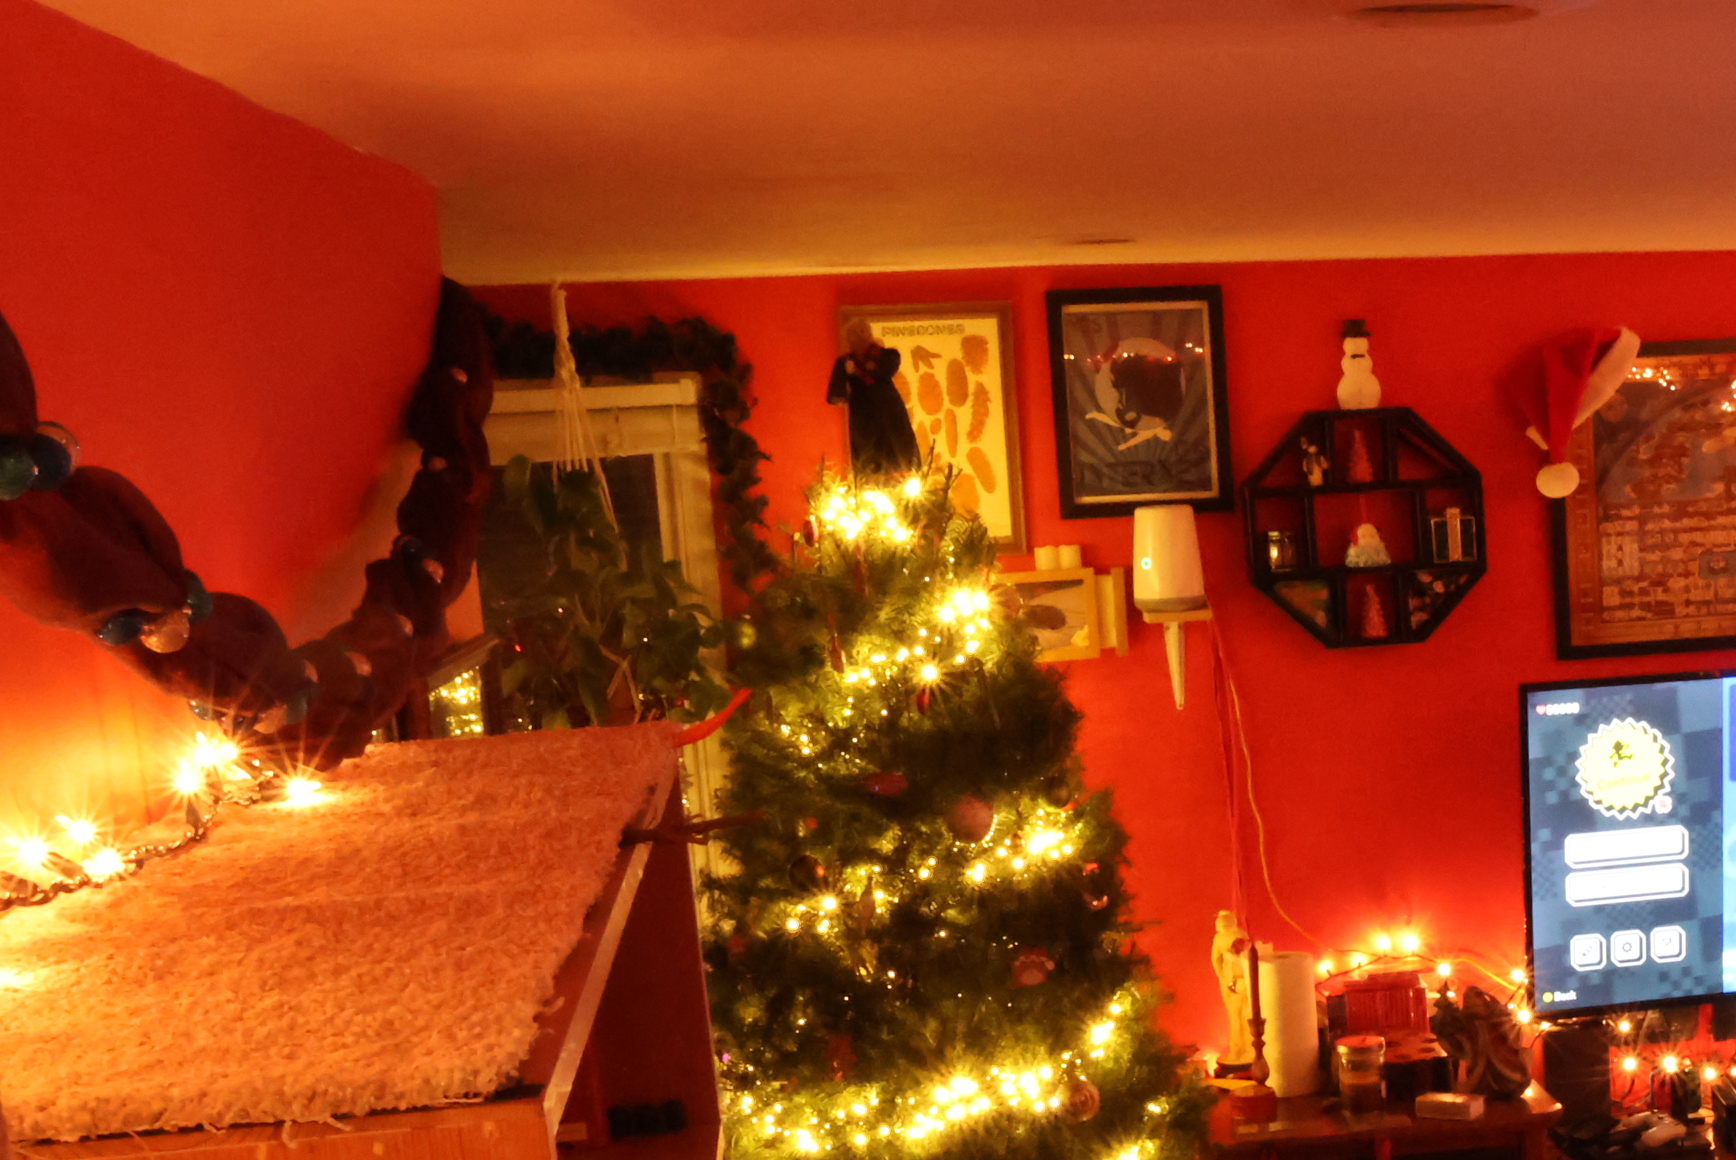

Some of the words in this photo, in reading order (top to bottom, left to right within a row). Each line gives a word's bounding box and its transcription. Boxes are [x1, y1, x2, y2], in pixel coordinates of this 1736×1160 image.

[881, 323, 966, 337] PINECONES
[1597, 774, 1651, 791] Continue
[1553, 989, 1577, 1002] Back
